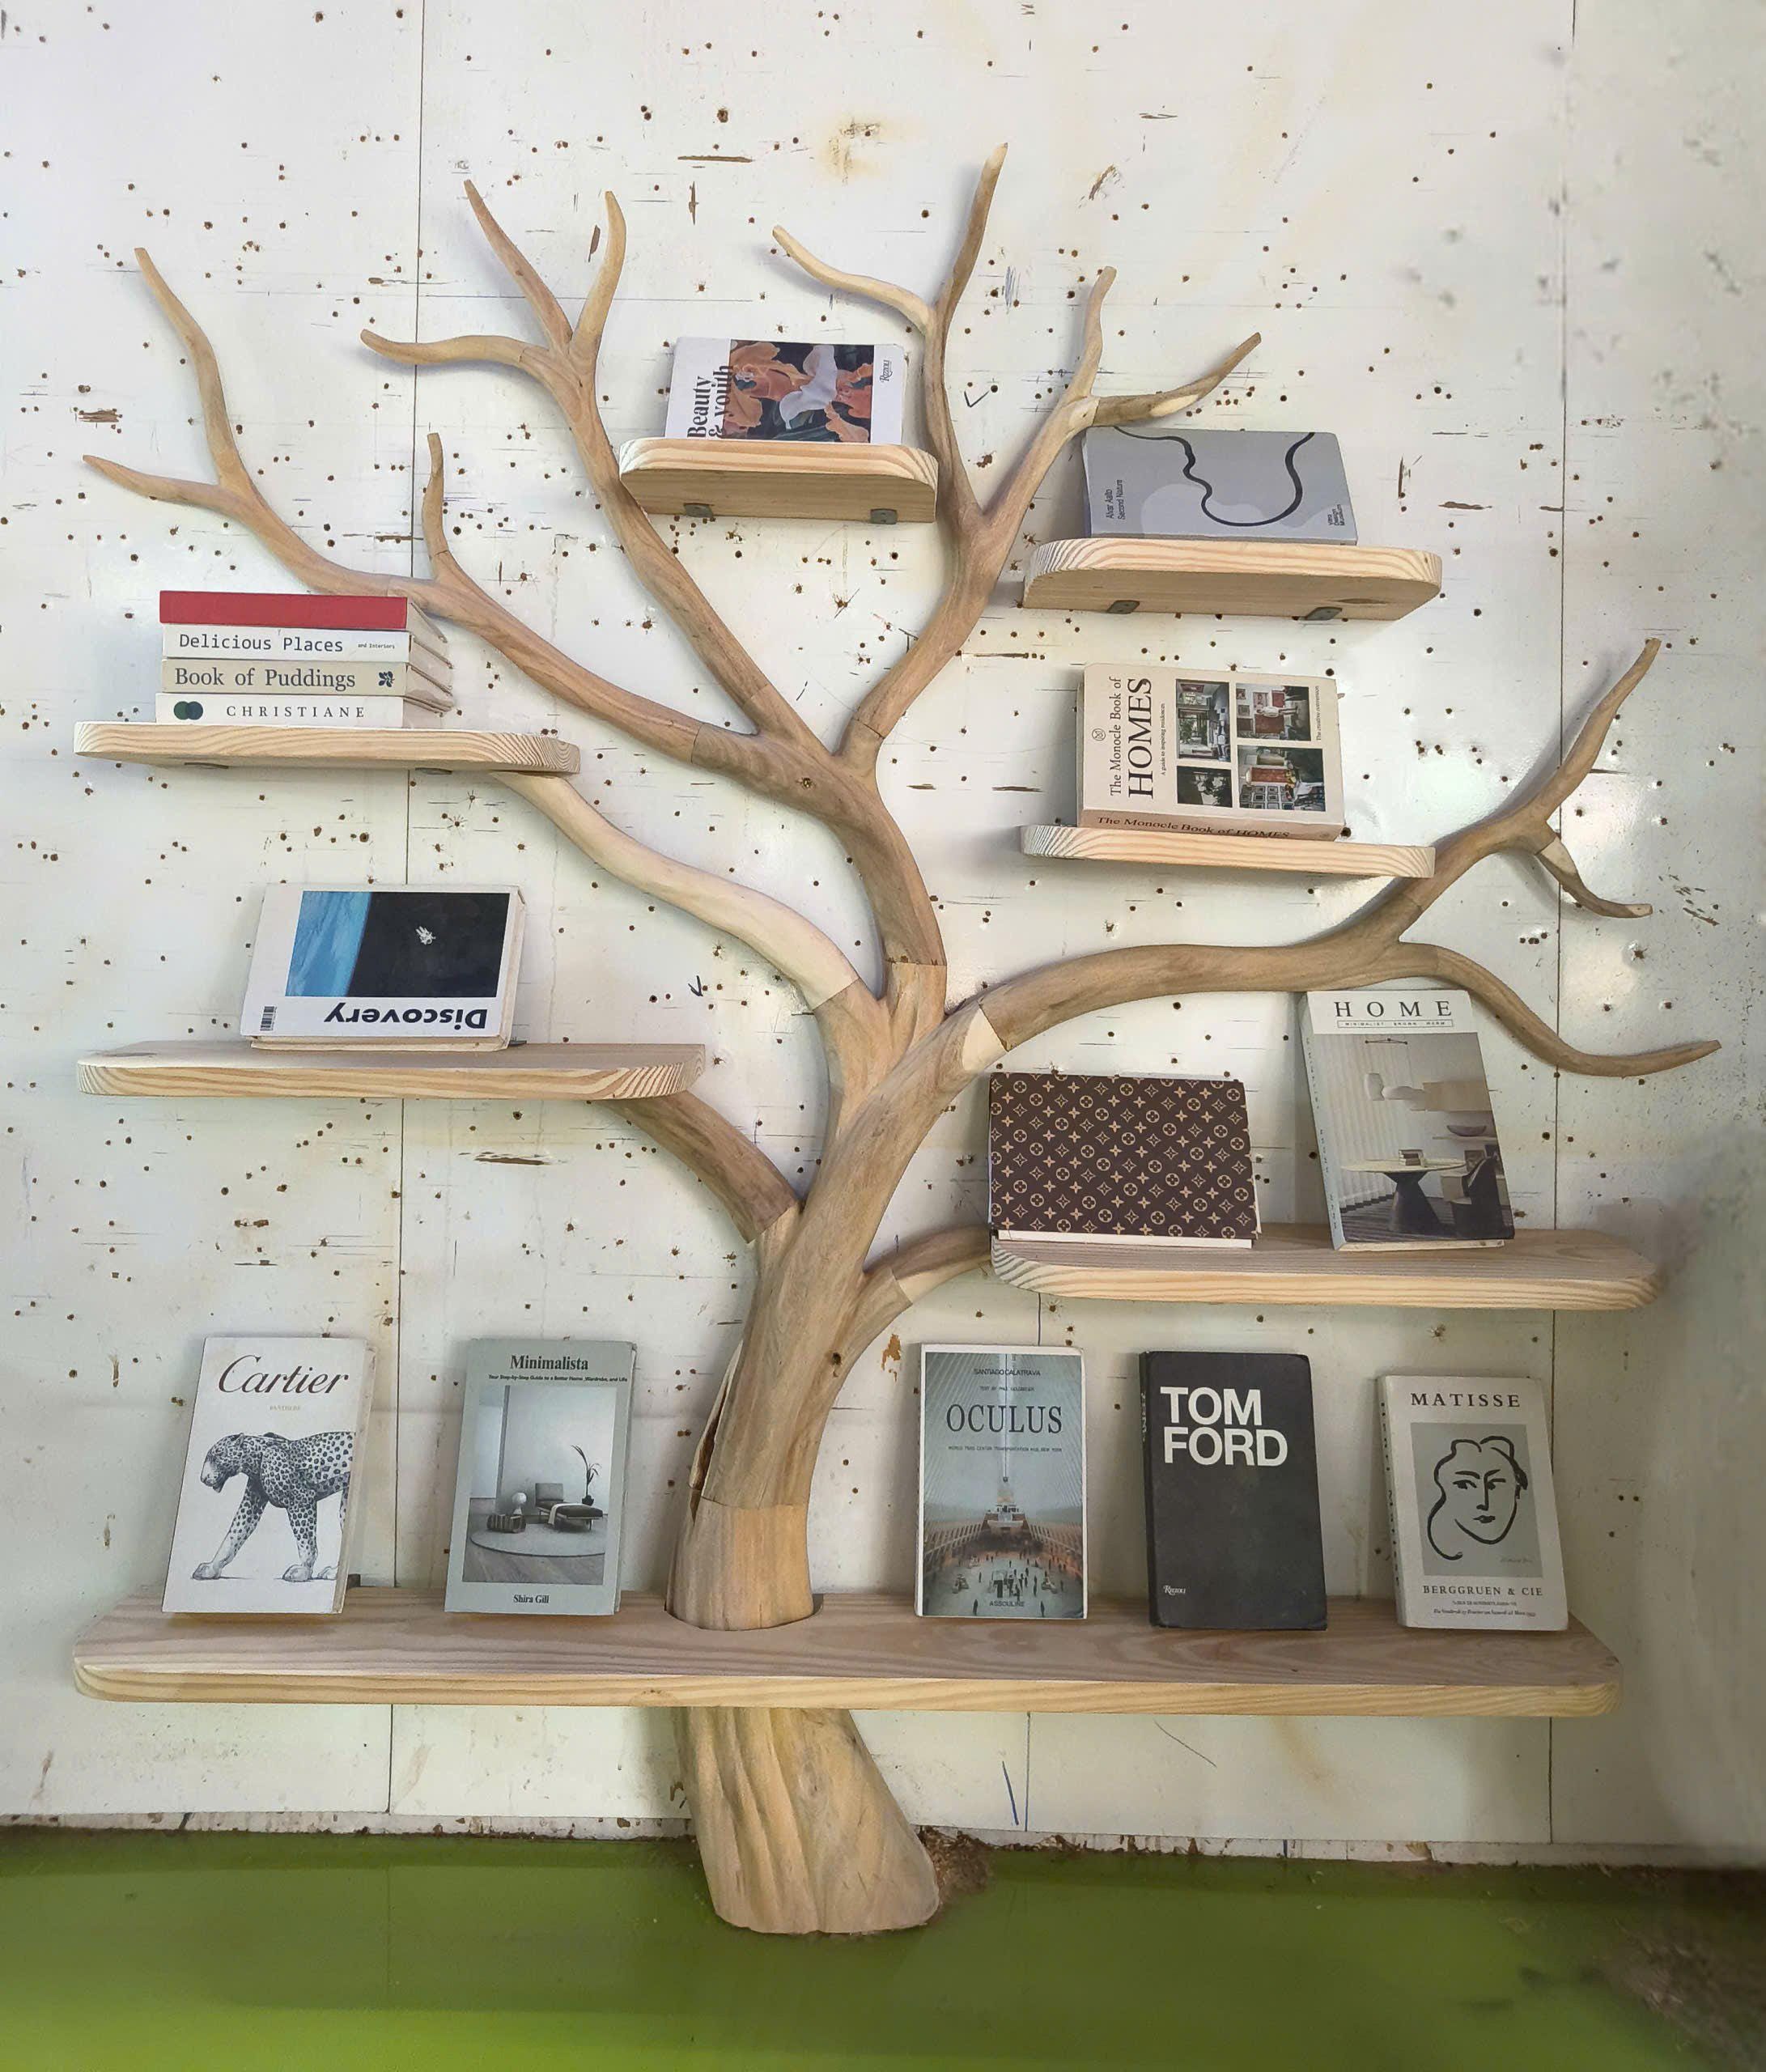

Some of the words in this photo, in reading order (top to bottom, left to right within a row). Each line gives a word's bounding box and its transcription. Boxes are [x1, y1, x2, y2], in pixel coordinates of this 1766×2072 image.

[687, 376, 715, 438] Beauty
[708, 425, 724, 439] &
[1106, 504, 1114, 520] Alvar
[1116, 499, 1126, 520] Second
[179, 634, 272, 651] Delicious
[282, 636, 344, 652] Places
[175, 668, 224, 686] Book
[235, 668, 256, 686] of
[265, 669, 356, 692] Puddings
[1109, 677, 1122, 689] of
[226, 706, 365, 719] CHRISTIANE
[1109, 693, 1122, 720] Book
[1109, 724, 1122, 771] Monocle
[1127, 677, 1154, 800] HOMES
[1110, 774, 1122, 796] The
[1097, 817, 1120, 825] The
[1123, 819, 1179, 830] Monocle
[1181, 824, 1213, 834] Book
[1218, 828, 1234, 836] of
[323, 1002, 488, 1030] Discovery
[1333, 1000, 1452, 1018] HOME
[510, 1355, 589, 1371] Minimalista
[973, 1368, 1004, 1376] SANTIAGO
[1004, 1369, 1041, 1377] CALATRAVA
[218, 1354, 350, 1394] Cartier
[1160, 1386, 1263, 1427] TOM
[1410, 1392, 1521, 1408] MATISSE
[945, 1403, 1063, 1434] OCULUS
[1163, 1425, 1289, 1467] FORD
[513, 1594, 534, 1604] Shira
[535, 1594, 550, 1604] Gill
[1423, 1585, 1501, 1595] BERGGRUEN
[1508, 1587, 1516, 1596] &
[1522, 1587, 1543, 1596] CIE
